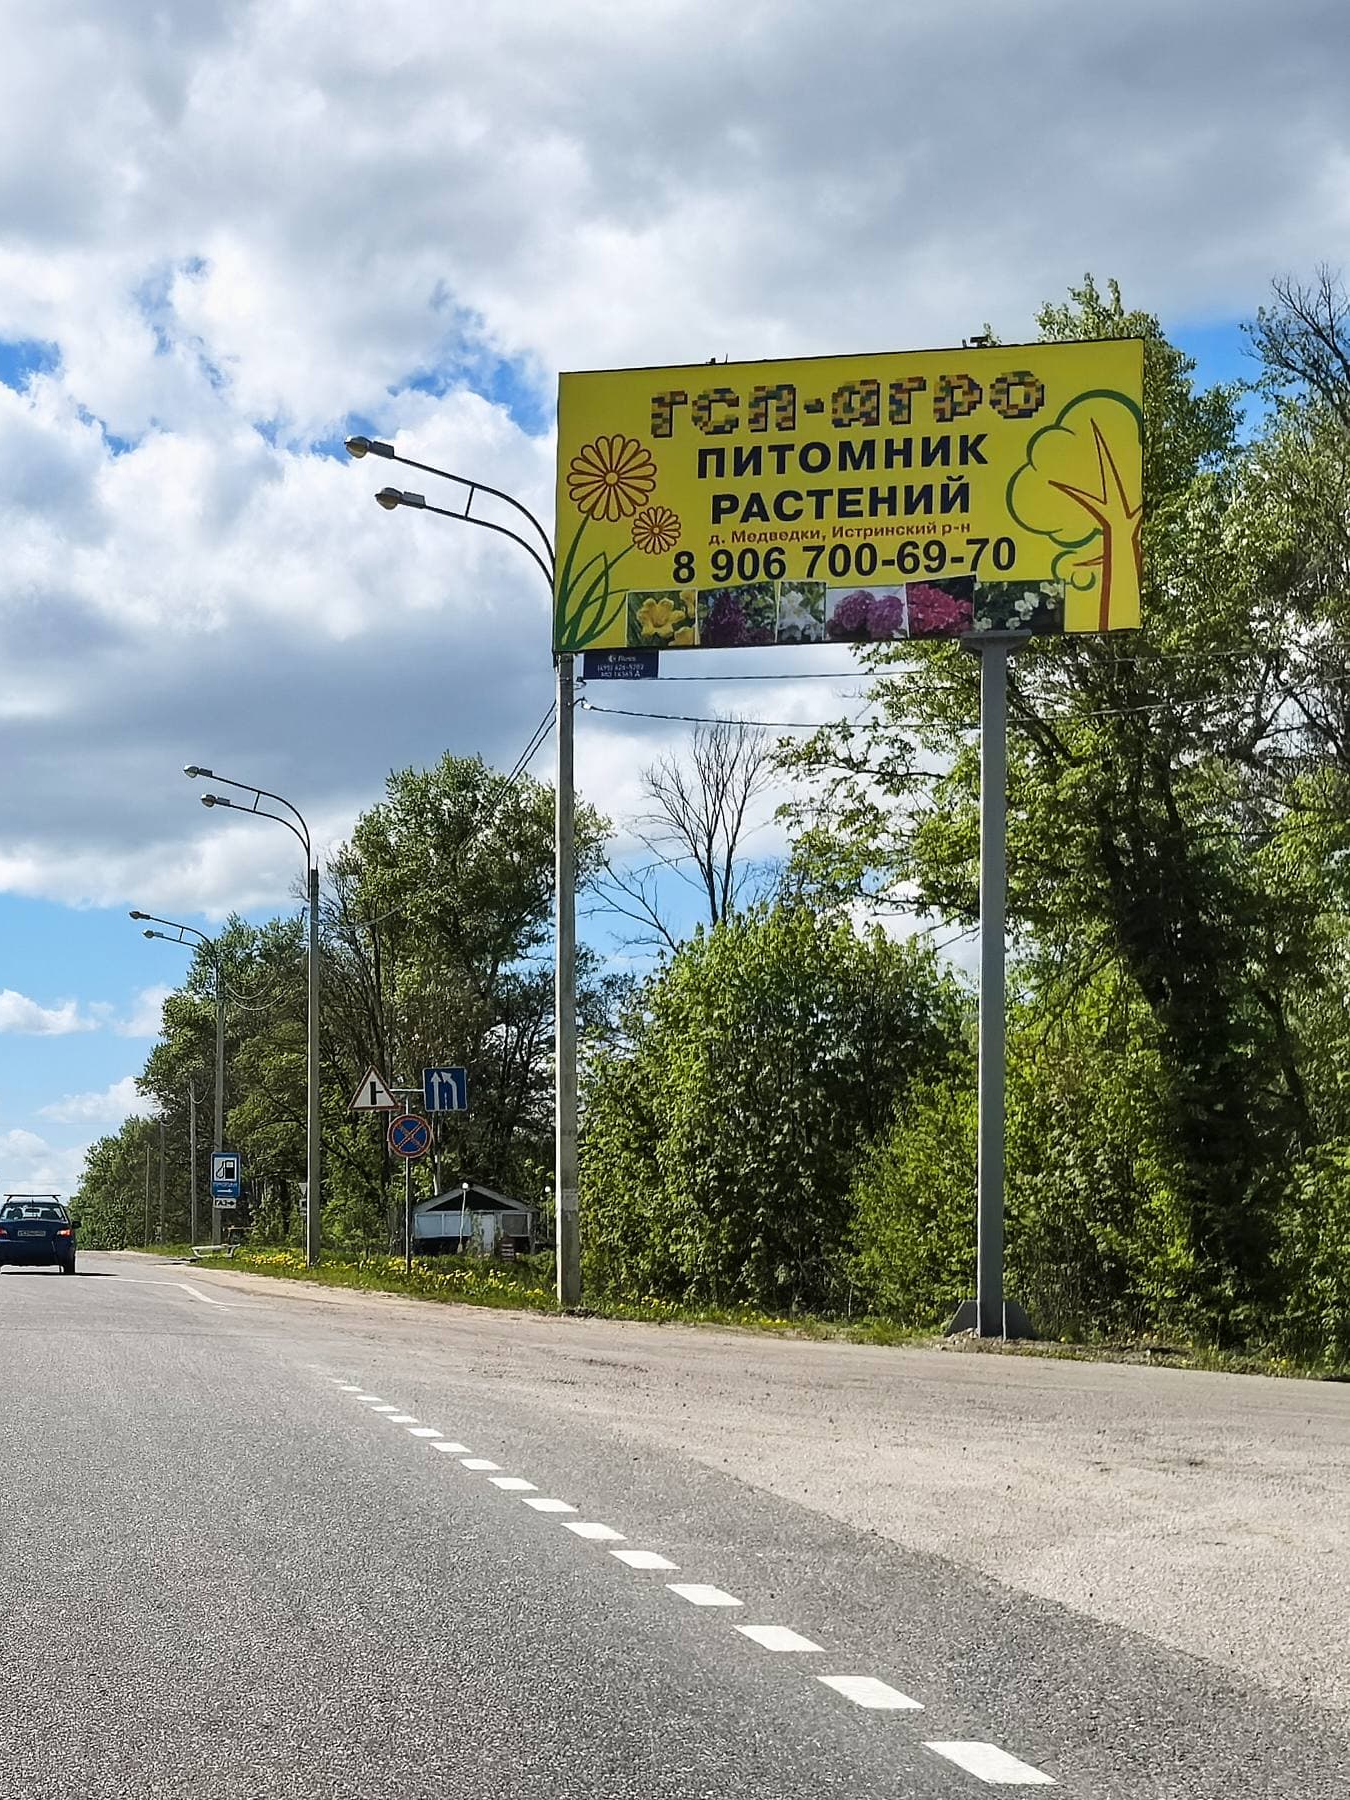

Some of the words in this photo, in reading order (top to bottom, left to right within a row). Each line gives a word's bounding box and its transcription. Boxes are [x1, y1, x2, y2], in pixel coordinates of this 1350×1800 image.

[696, 433, 989, 479] ПИТОМНИК
[710, 475, 971, 525] РАСТЕНИЙ
[730, 528, 828, 545] Медведки,
[831, 521, 937, 539] Истринский
[941, 523, 971, 536] р-н
[672, 551, 696, 584] 8
[710, 547, 787, 582] 906
[802, 537, 1017, 578] 700-69-70
